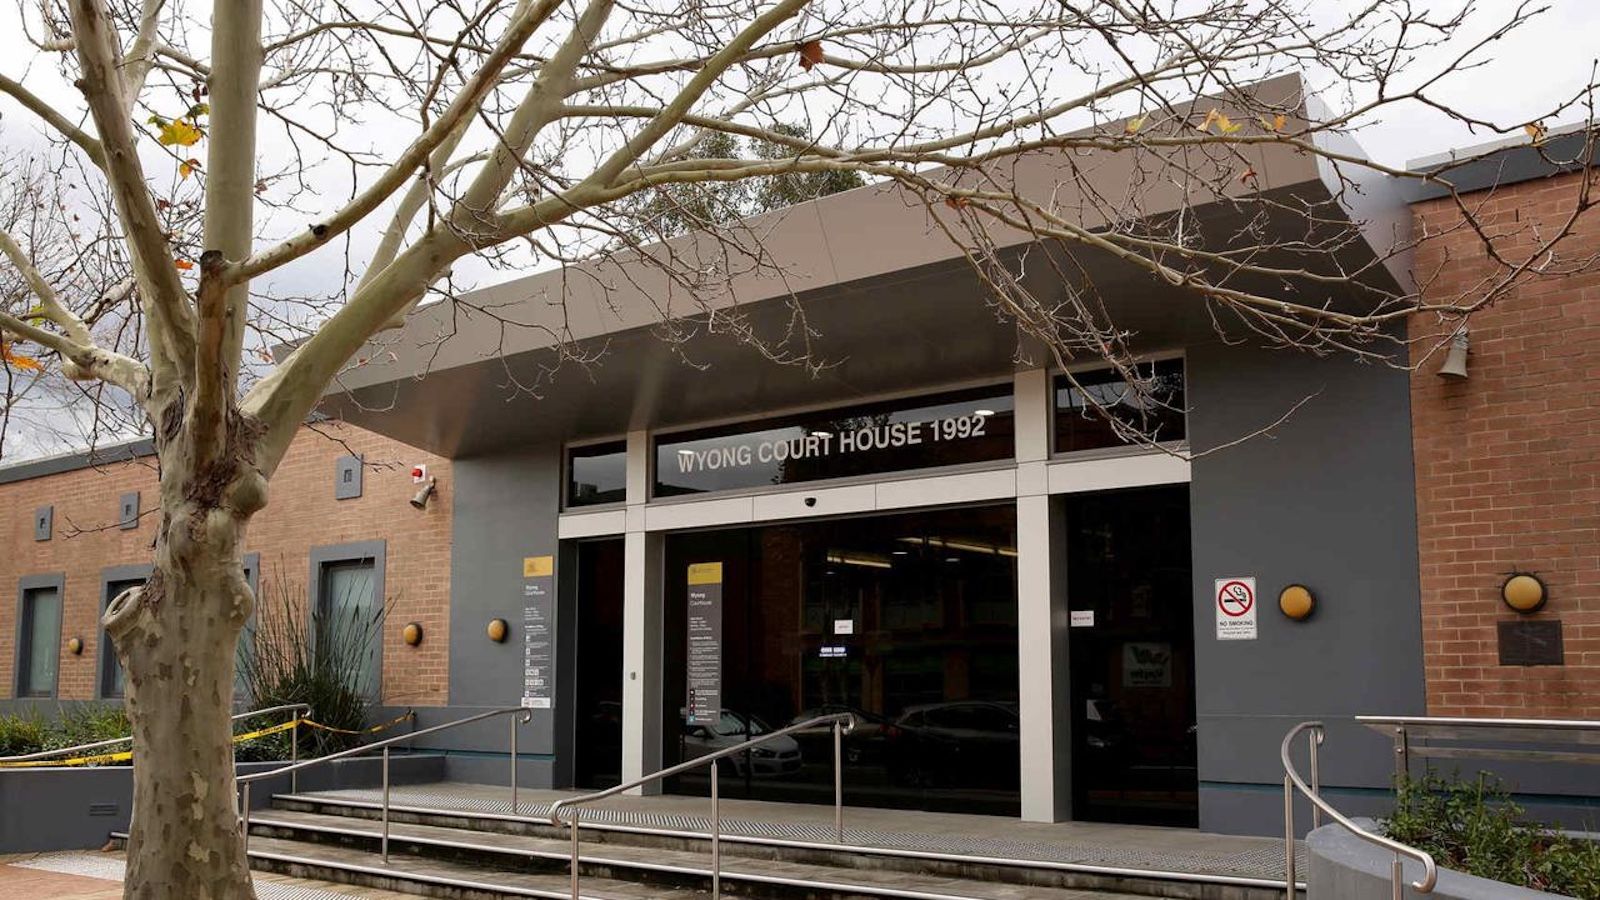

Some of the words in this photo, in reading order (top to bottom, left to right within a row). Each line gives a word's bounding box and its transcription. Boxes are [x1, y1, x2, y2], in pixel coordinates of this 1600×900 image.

[677, 445, 751, 473] WYONG
[758, 435, 832, 463] COURT
[839, 422, 922, 453] HOUSE
[930, 415, 986, 441] 1992
